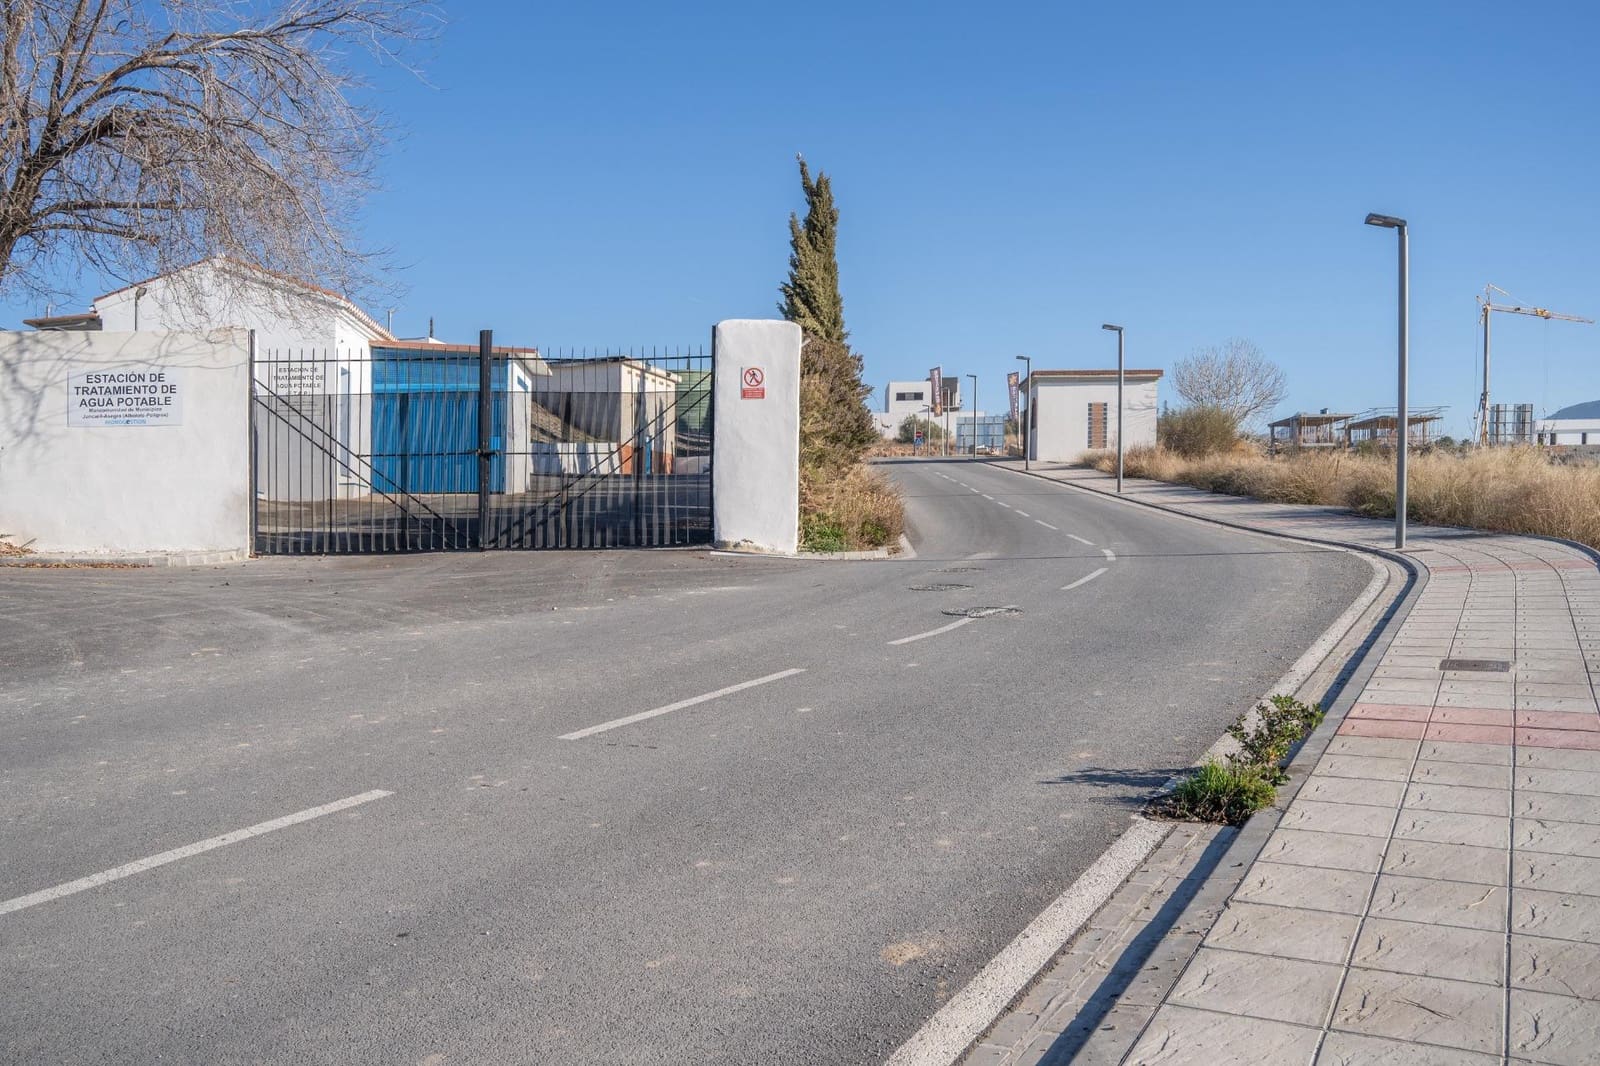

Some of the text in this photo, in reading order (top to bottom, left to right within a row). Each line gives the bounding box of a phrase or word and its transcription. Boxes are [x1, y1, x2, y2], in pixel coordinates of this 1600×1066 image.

[86, 371, 166, 384] ESTACIÓN DE
[74, 384, 177, 396] TRATAMIENTO DE
[79, 396, 172, 408] AGUA POTABLE
